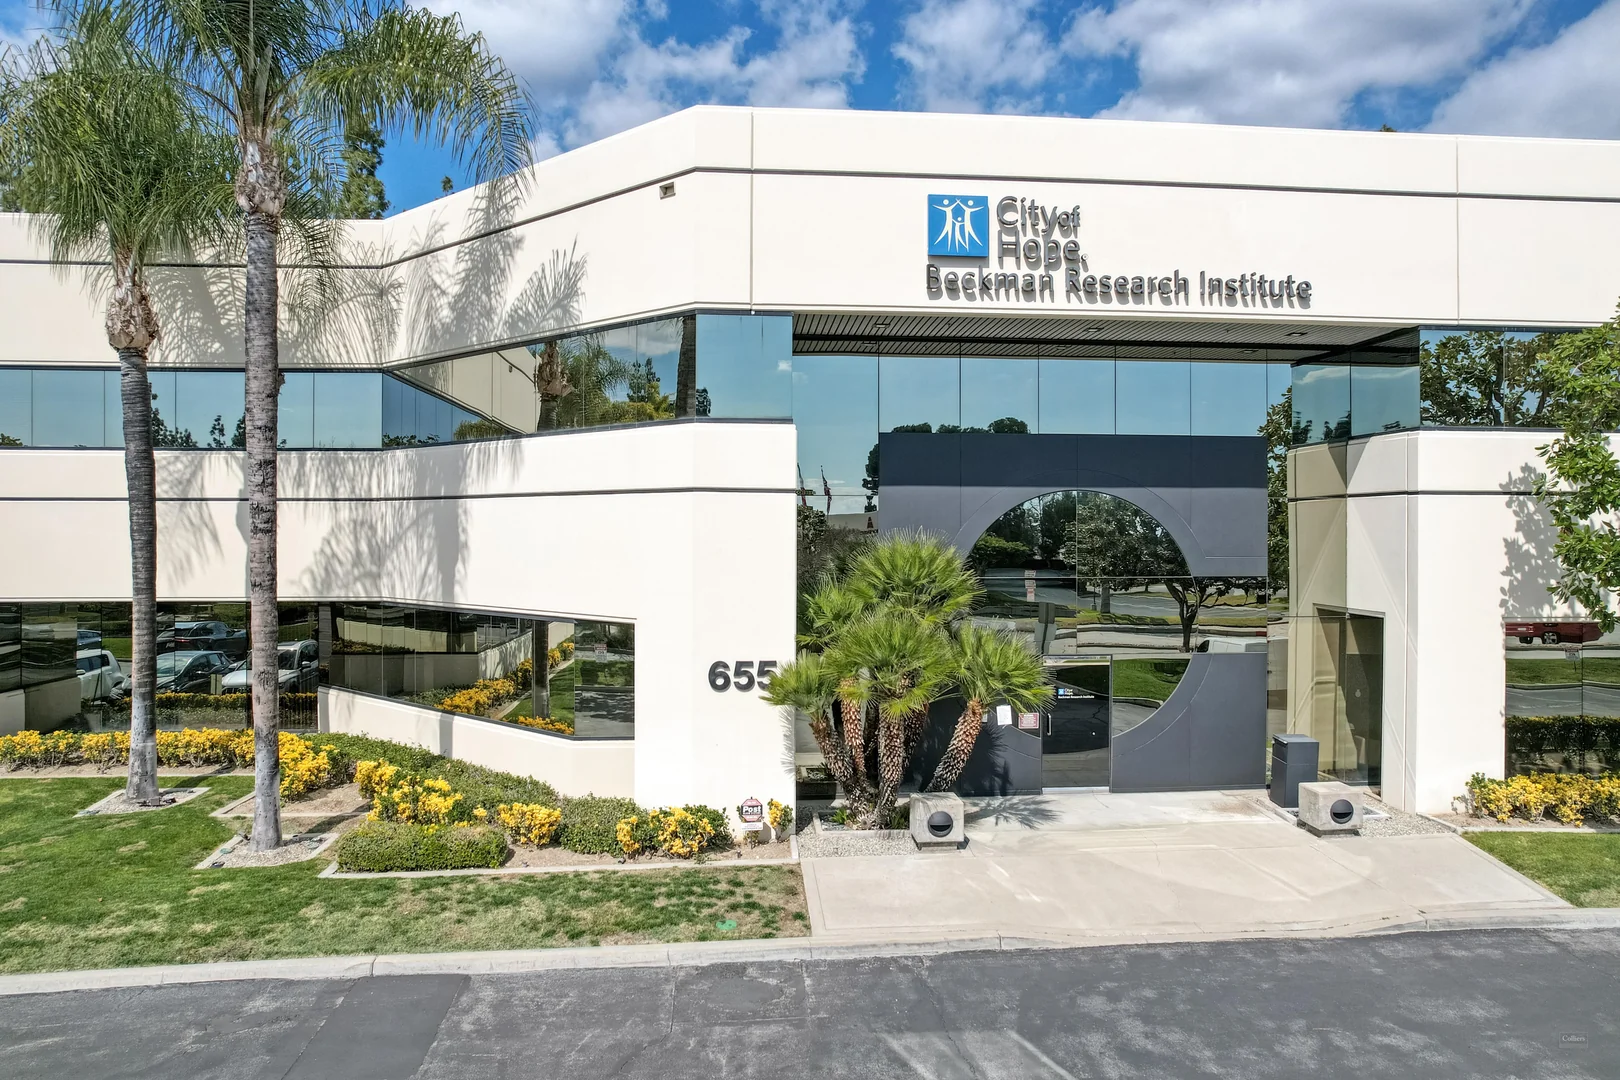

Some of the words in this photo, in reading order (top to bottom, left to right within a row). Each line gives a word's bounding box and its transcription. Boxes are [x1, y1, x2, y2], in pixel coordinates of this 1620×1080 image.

[997, 196, 1058, 235] City
[1058, 205, 1081, 228] of
[926, 263, 1054, 292] Beckman
[1065, 267, 1190, 295] Research
[1200, 270, 1312, 299] Institute
[708, 660, 778, 692] 655
[742, 805, 762, 813] Post
